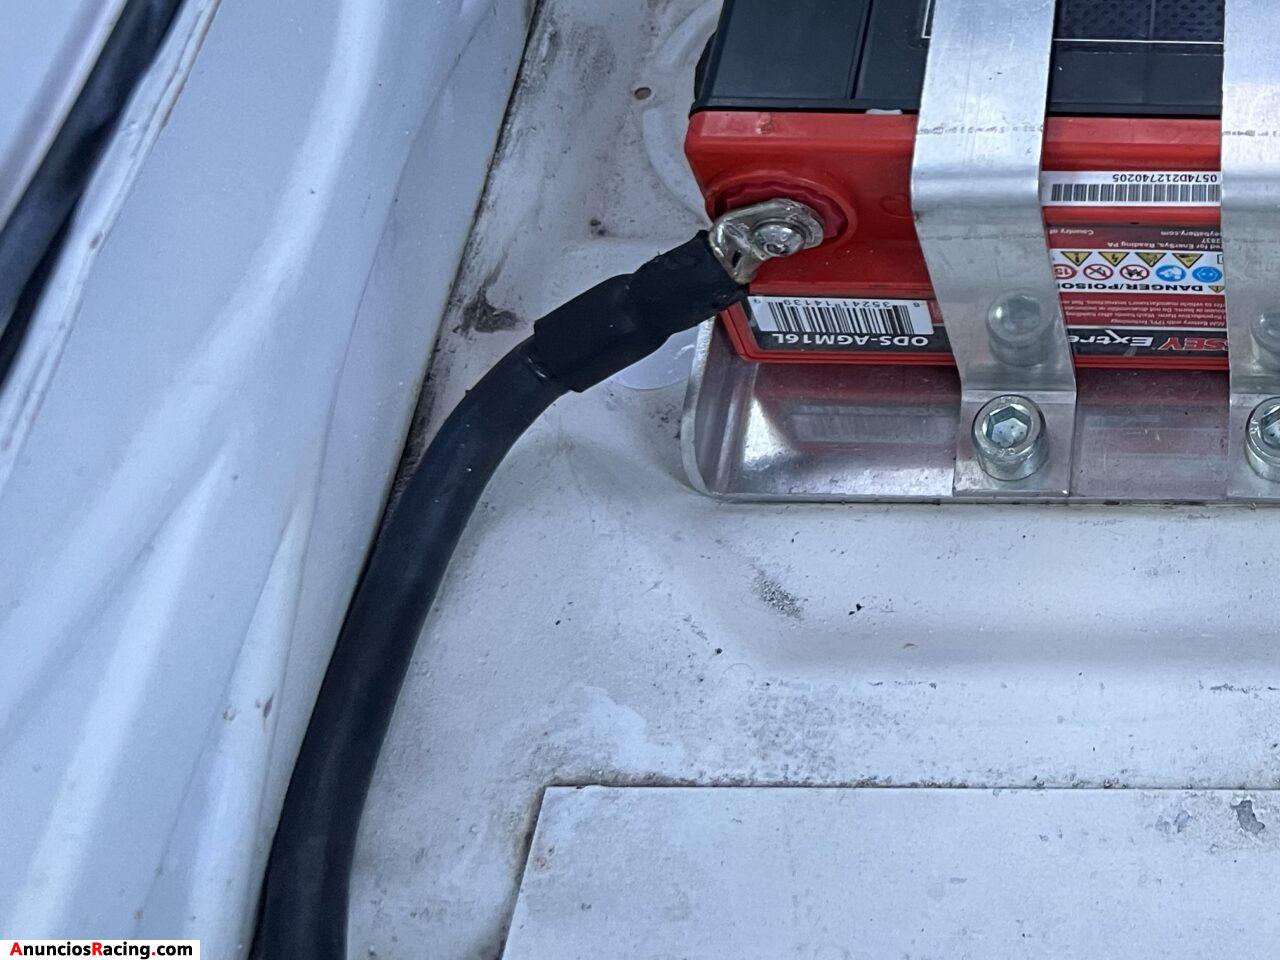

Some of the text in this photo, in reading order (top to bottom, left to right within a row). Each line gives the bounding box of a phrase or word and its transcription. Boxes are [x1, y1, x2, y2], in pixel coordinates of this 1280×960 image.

[1112, 173, 1218, 183] 0574D212740205
[782, 299, 831, 307] 14139
[842, 300, 890, 308] 35241
[772, 334, 928, 346] ODS-AGM16L
[1158, 338, 1228, 351] SEY
